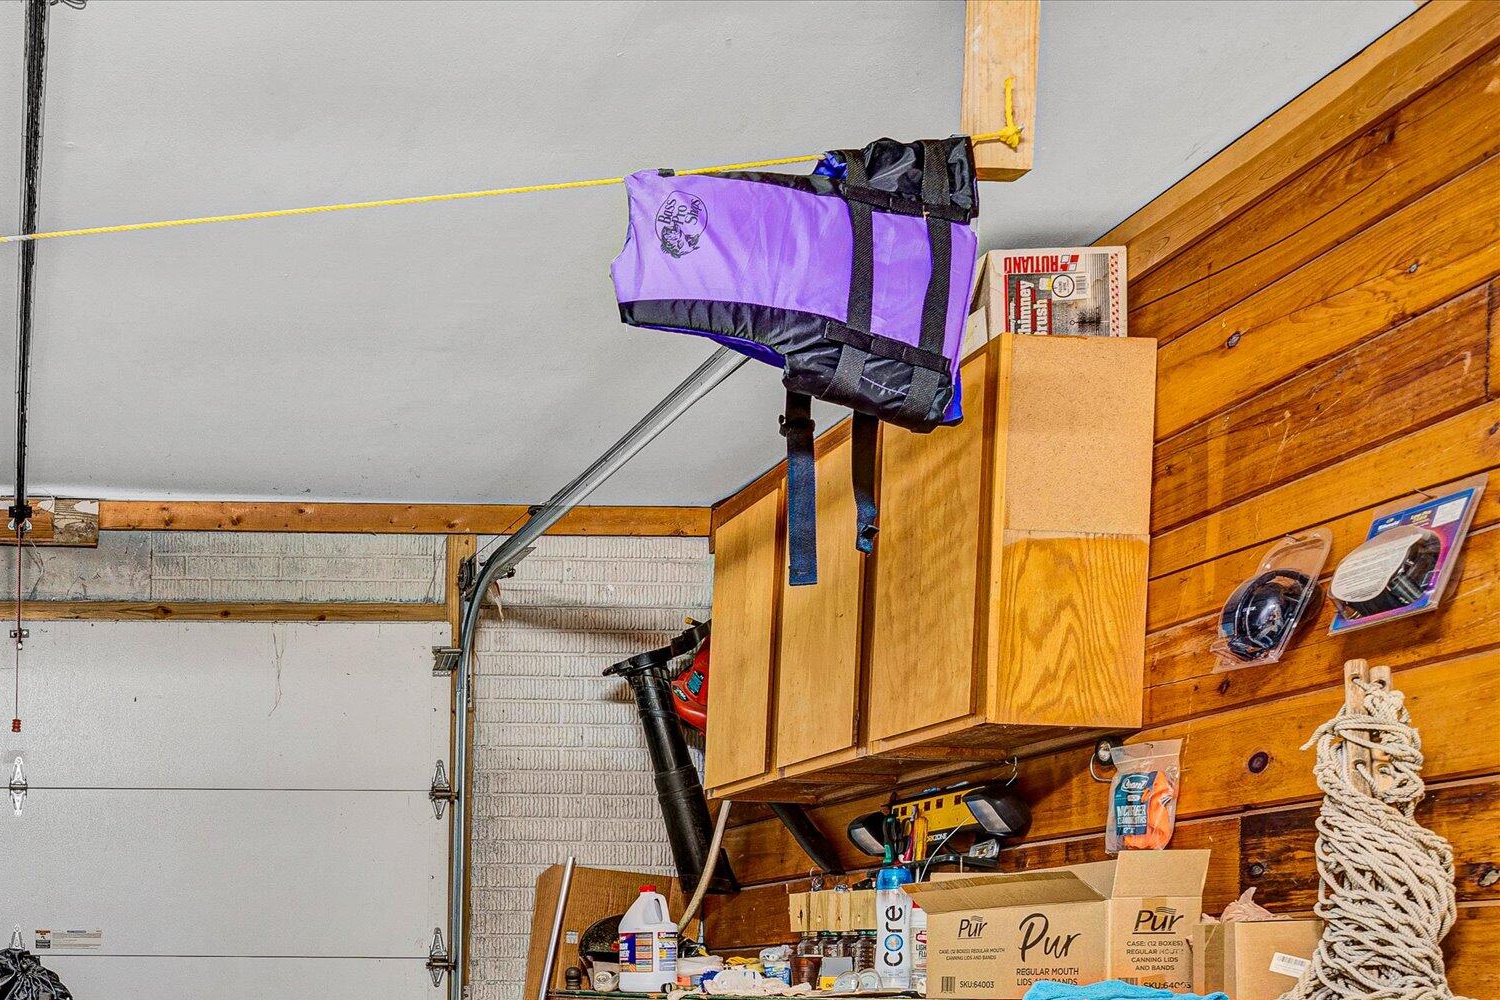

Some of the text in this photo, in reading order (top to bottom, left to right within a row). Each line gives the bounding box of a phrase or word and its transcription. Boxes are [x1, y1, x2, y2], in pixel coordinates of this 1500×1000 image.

[658, 199, 676, 224] Bass
[672, 205, 687, 225] Pro
[1004, 255, 1058, 273] RUTLAND
[1018, 281, 1034, 334] himney
[958, 919, 988, 938] Pur
[1134, 909, 1184, 931] Pur
[884, 905, 903, 967] core
[1018, 913, 1081, 962] Pur
[1016, 967, 1079, 976] REGULAR MOUTH
[960, 980, 994, 989] SKU:64003
[1016, 978, 1032, 986] LIDS
